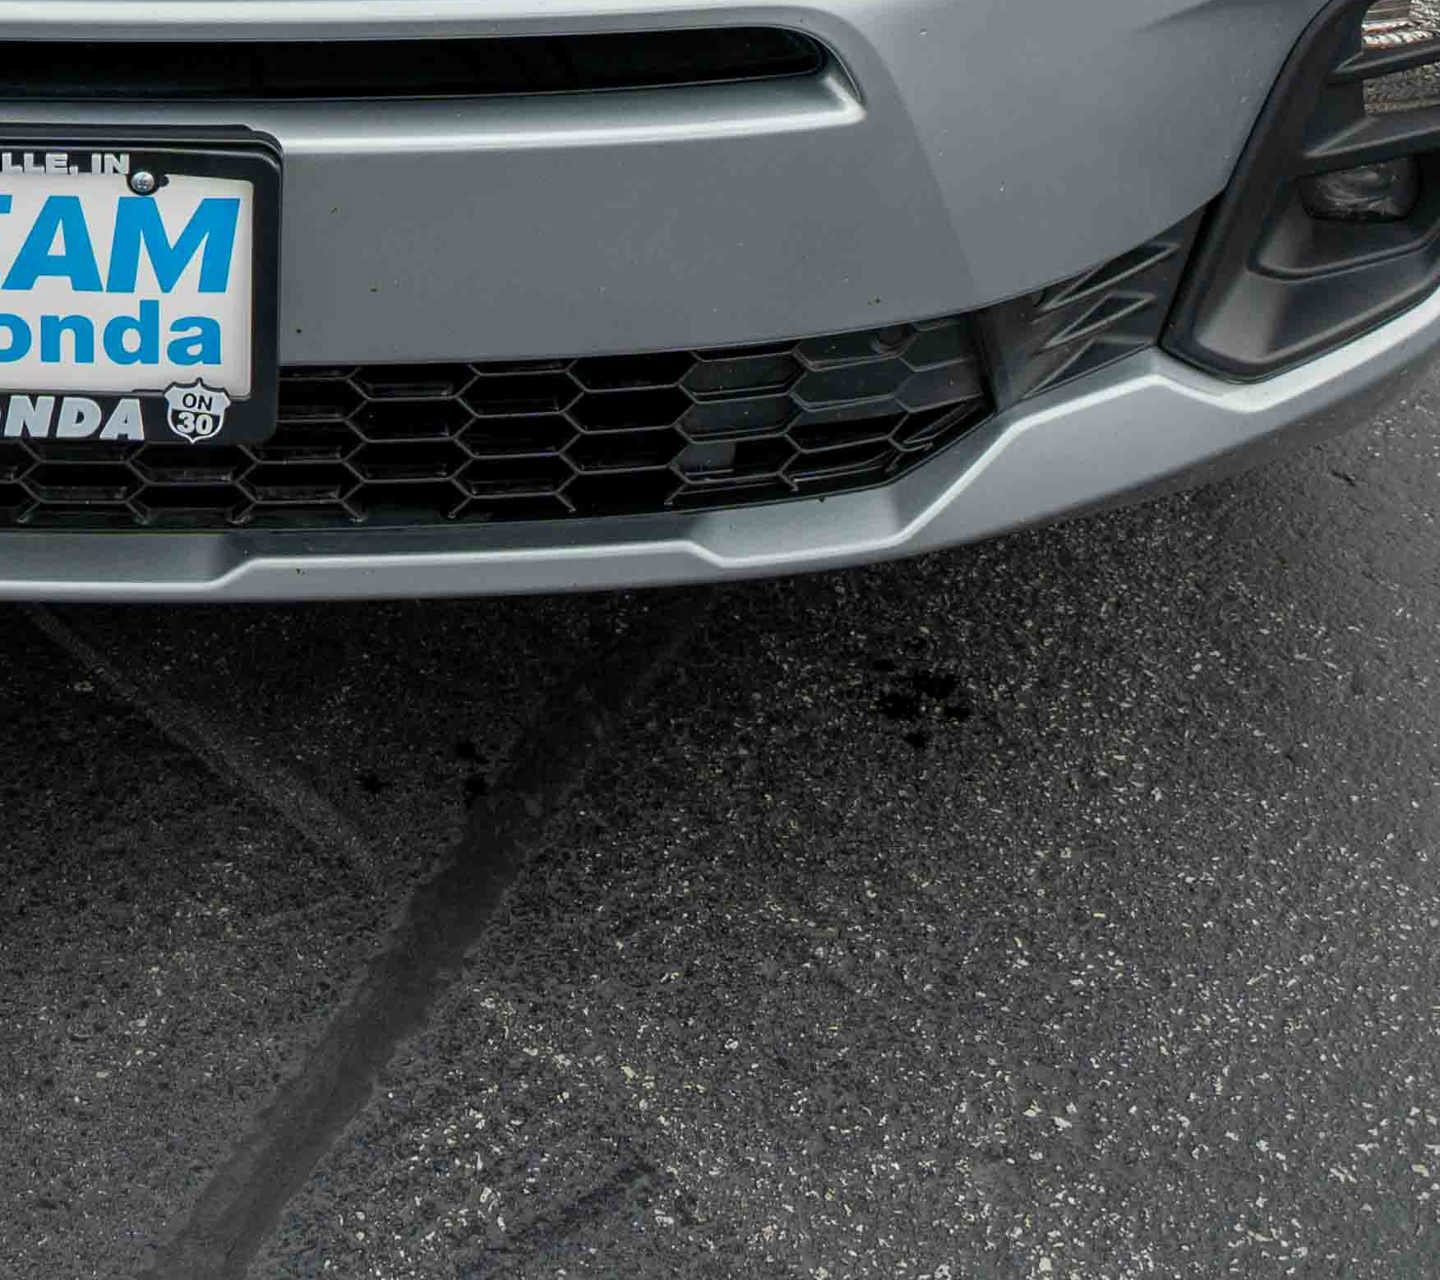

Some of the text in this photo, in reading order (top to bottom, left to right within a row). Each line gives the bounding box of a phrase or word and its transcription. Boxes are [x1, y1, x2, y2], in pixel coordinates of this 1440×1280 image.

[91, 151, 131, 176] IN
[182, 392, 214, 412] ON
[176, 411, 214, 436] 30
